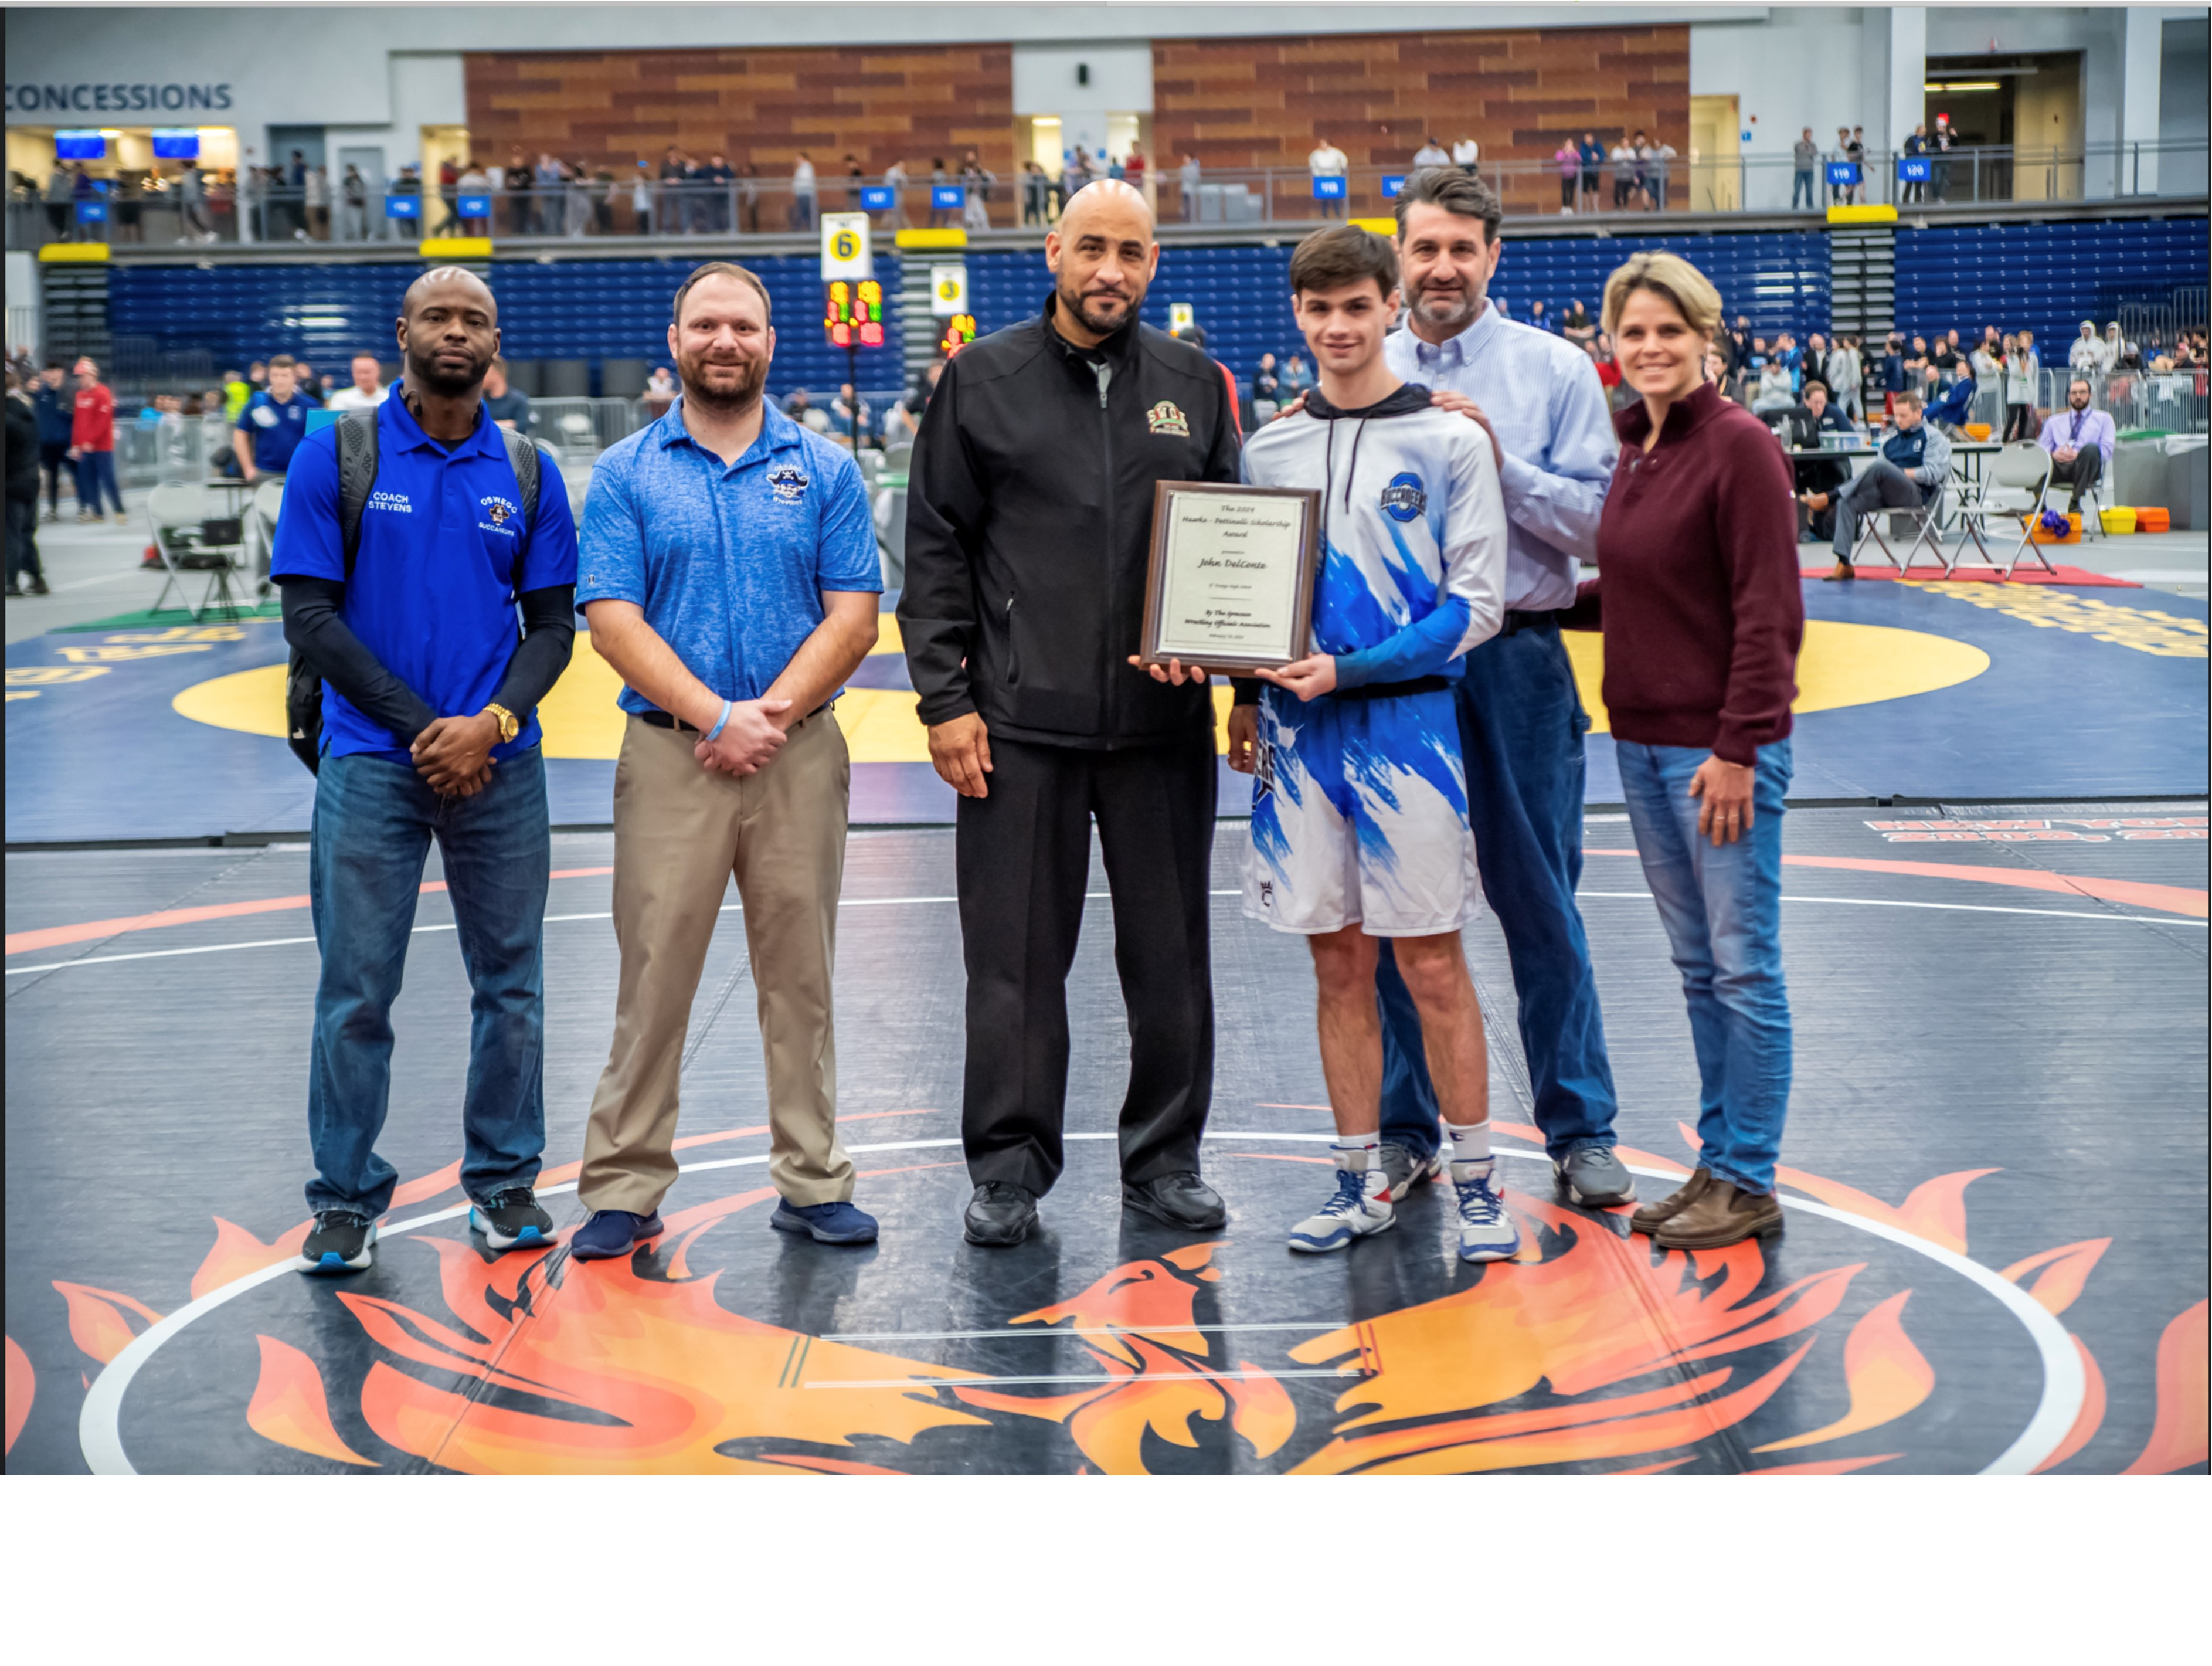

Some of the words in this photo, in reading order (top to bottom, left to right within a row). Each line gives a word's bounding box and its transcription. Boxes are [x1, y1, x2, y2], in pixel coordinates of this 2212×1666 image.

[838, 233, 852, 257] 6
[373, 491, 409, 504] COACH
[368, 501, 412, 513] STEVENS
[1250, 519, 1292, 529] Scholarship
[1197, 557, 1222, 569] John
[1863, 820, 2051, 830] NEW
